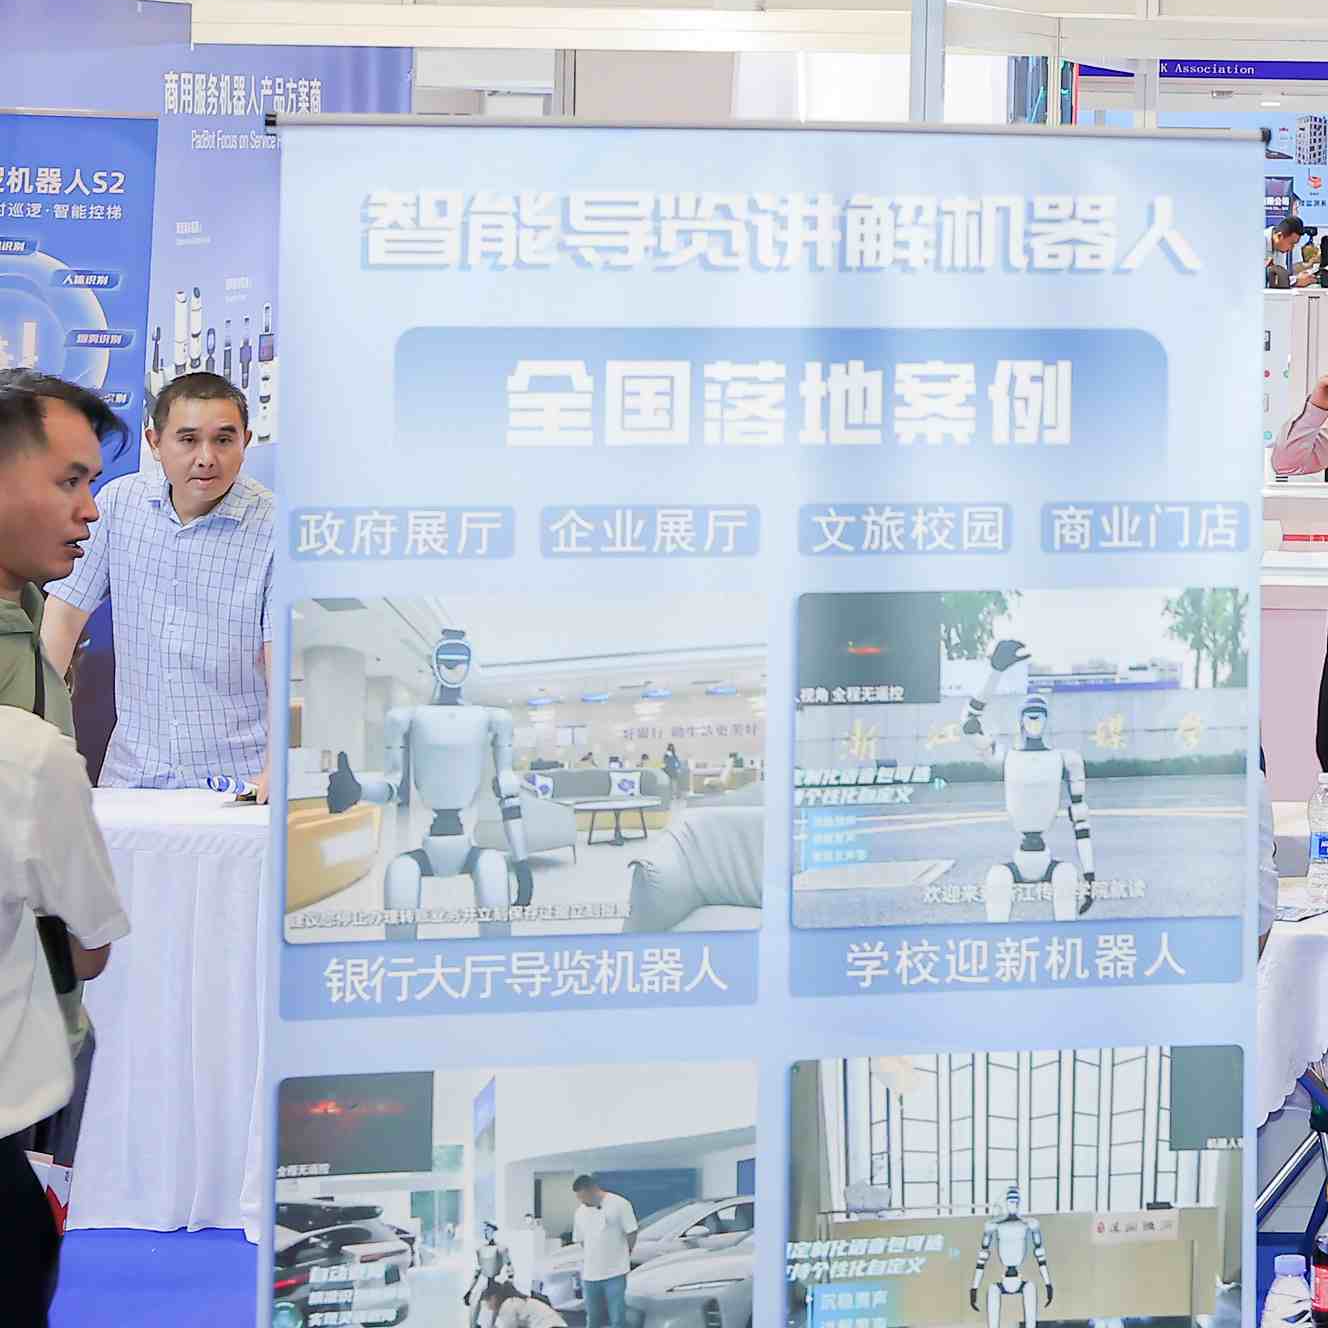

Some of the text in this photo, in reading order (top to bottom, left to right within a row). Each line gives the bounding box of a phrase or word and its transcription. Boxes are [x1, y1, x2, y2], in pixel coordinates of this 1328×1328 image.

[1175, 63, 1256, 76] Association
[164, 71, 321, 115] 商用服务机器人产品方案商
[0, 166, 126, 196] 机器人S2
[362, 190, 1201, 271] 智能导览讲解机器人
[506, 357, 1073, 448] 全国落地案例
[298, 509, 502, 555] 政府展厅
[549, 507, 749, 554] 企业展厅
[812, 506, 1005, 552] 文旅校园
[1051, 504, 1240, 550] 商业门店
[323, 945, 729, 1004] 银行大厅导览机器人
[846, 931, 1186, 987] 学校迎新机器人
